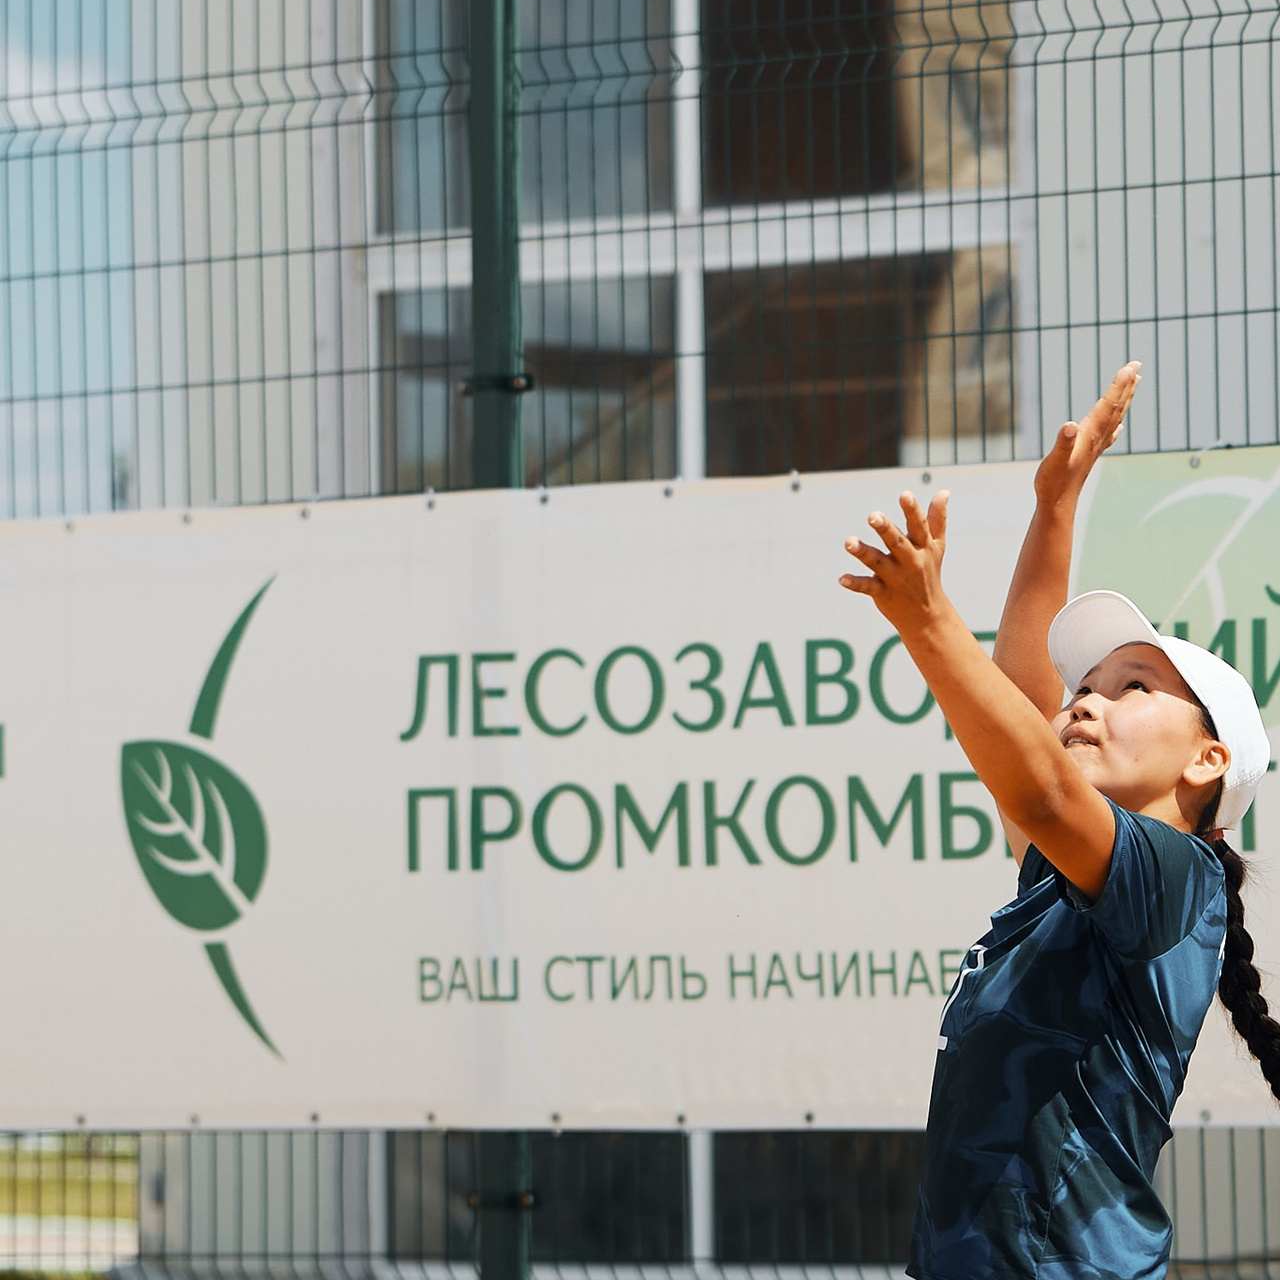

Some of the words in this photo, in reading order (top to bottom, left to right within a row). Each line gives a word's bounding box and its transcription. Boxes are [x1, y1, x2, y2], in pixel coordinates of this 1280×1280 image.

[406, 760, 1278, 872] ПРОМКОМБ
[417, 956, 520, 1003] ВАШ
[543, 954, 708, 1001] СТИЛЬ
[728, 949, 963, 999] НАЧИНАЕ
